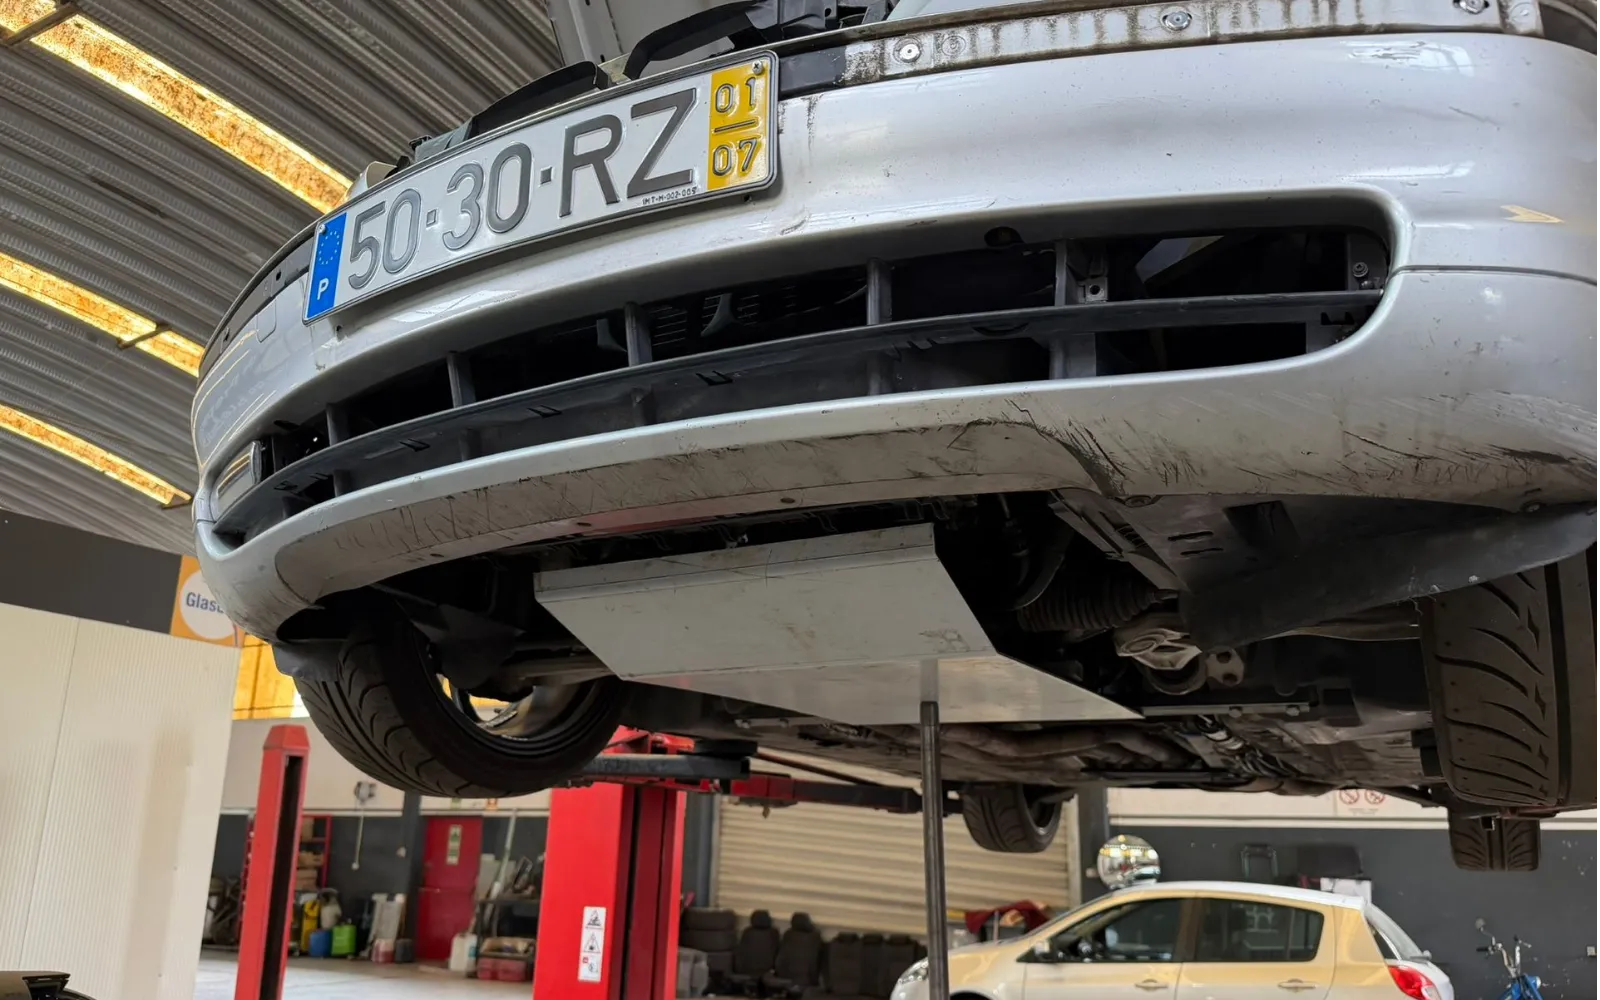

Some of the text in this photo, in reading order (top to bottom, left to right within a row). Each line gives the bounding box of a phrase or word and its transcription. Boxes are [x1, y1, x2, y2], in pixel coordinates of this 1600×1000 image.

[715, 76, 756, 113] 01
[713, 137, 758, 176] 07
[317, 278, 329, 300] P
